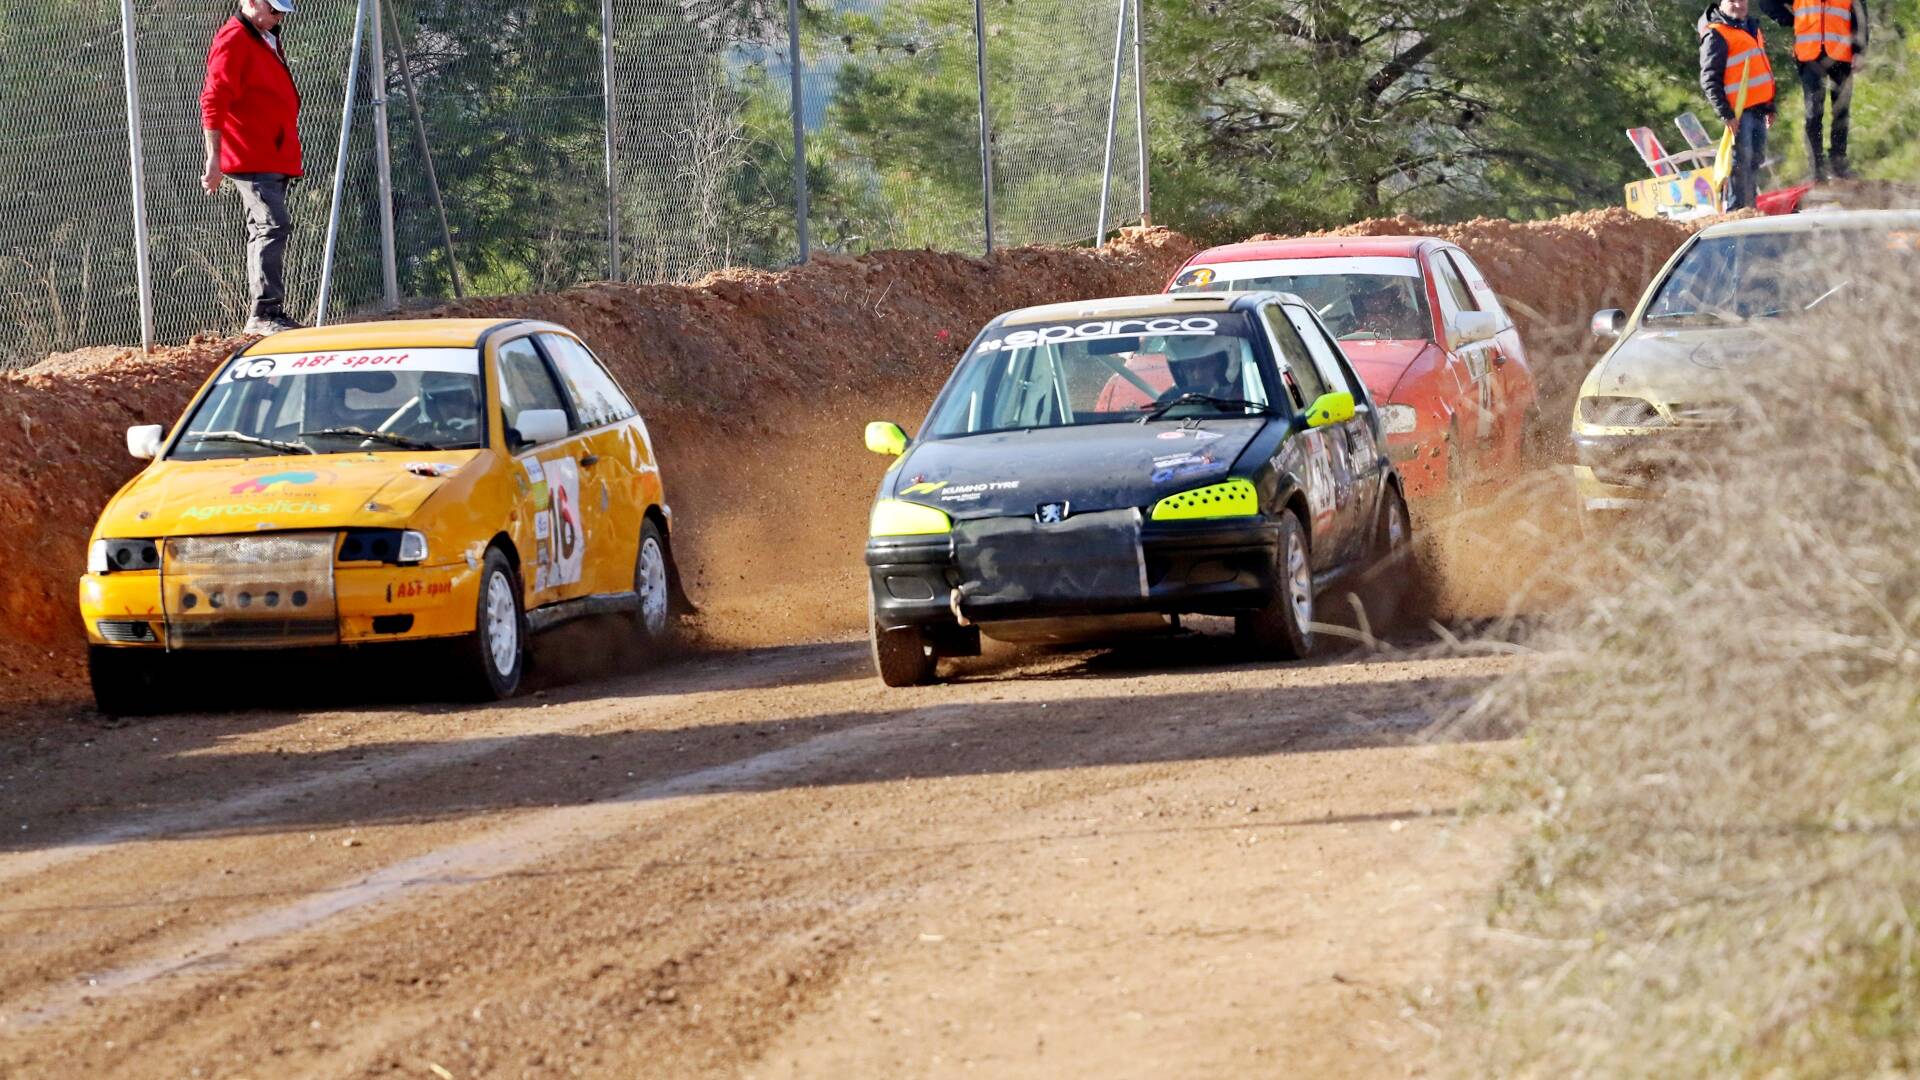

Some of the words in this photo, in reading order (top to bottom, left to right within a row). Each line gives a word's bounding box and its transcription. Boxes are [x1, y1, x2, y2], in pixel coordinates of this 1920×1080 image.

[232, 359, 275, 379] 16
[292, 355, 338, 368] ABF
[343, 354, 409, 368] sport
[941, 483, 988, 496] KUMHO
[989, 480, 1020, 490] TYRE
[547, 484, 575, 561] 16
